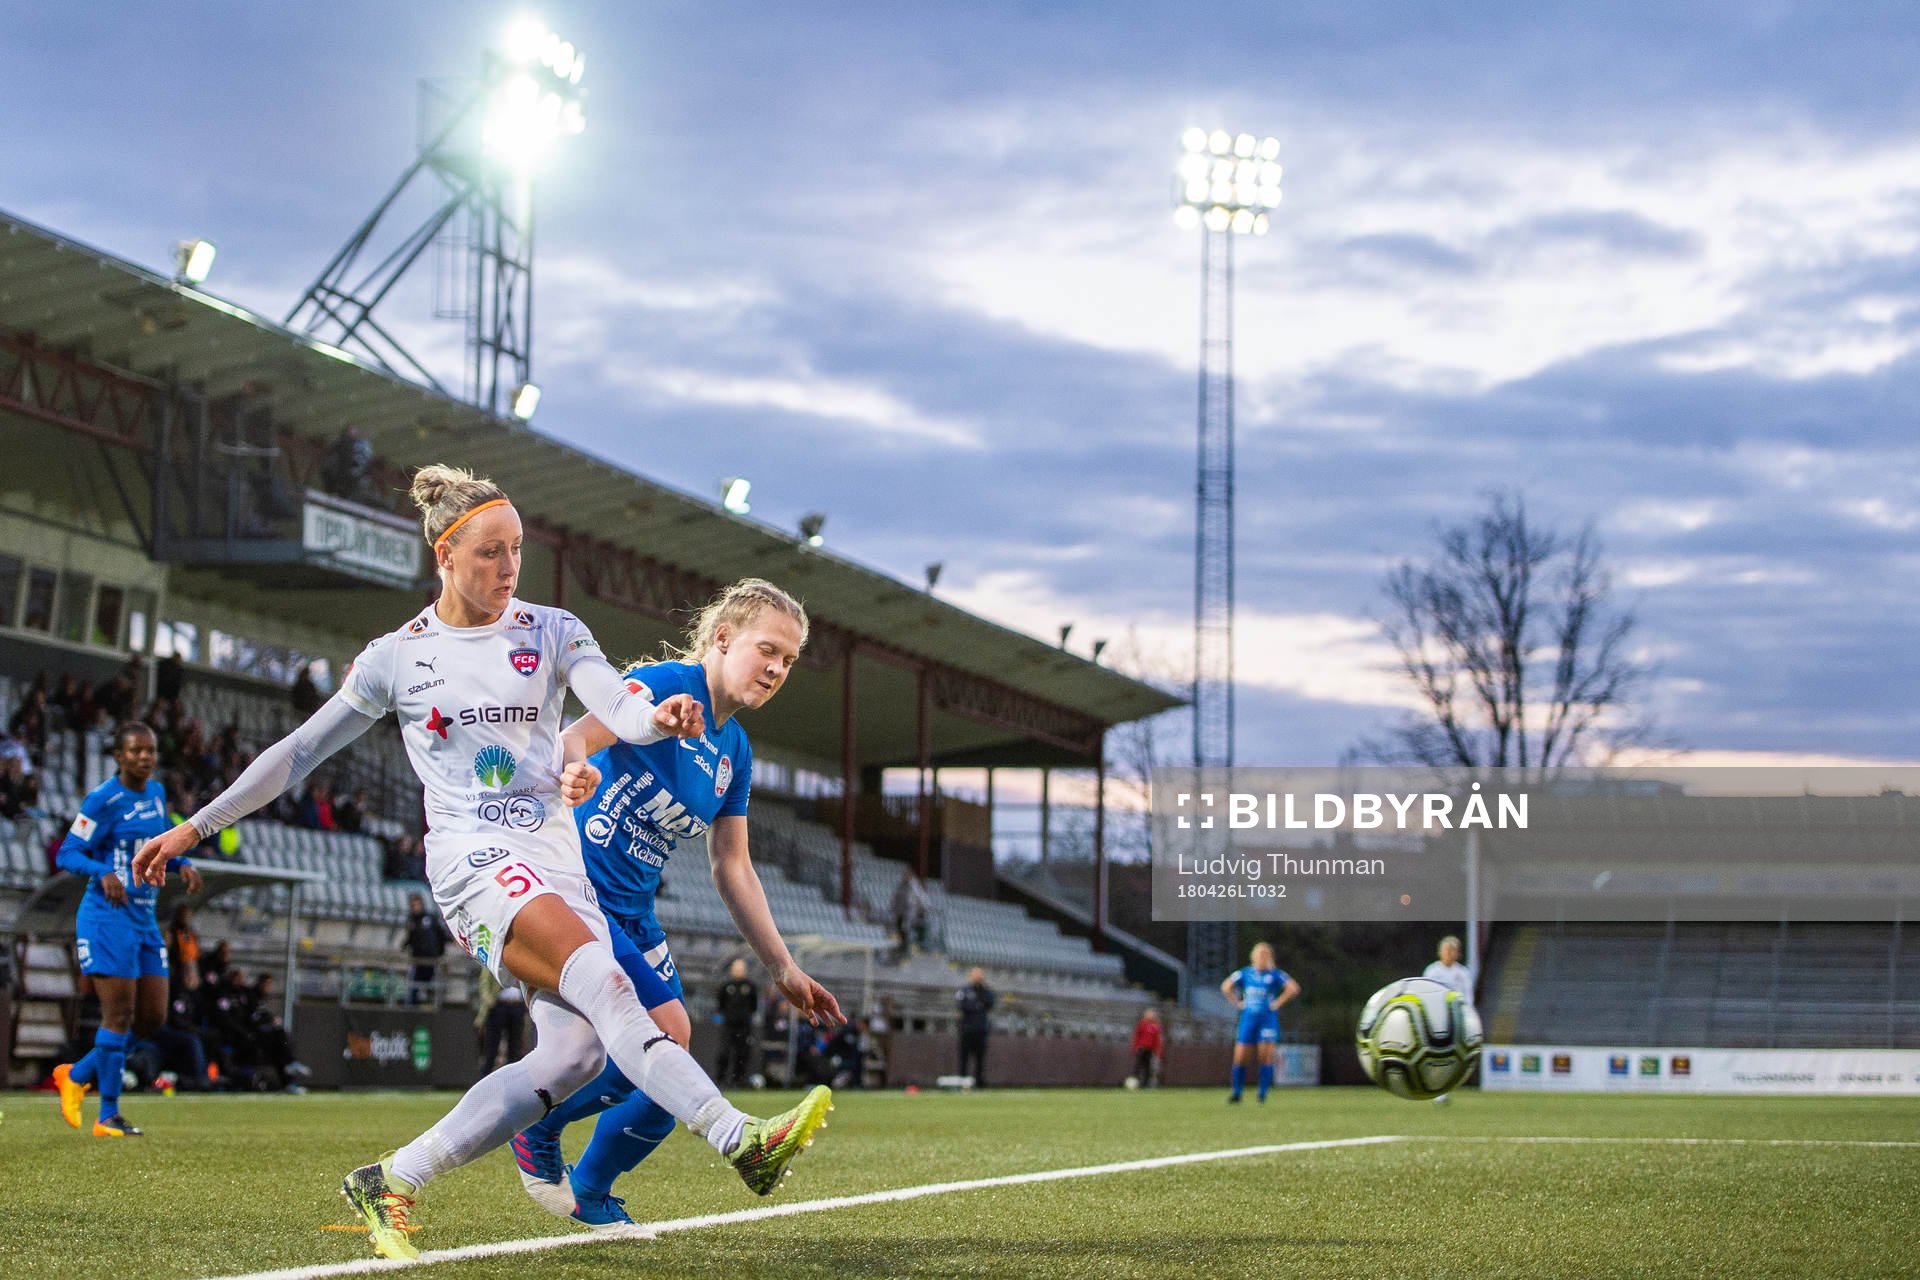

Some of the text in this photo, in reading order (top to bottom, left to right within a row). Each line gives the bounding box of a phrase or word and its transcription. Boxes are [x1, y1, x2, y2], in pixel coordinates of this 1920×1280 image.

[514, 655, 537, 665] FCR
[407, 678, 446, 696] stadium
[598, 772, 632, 812] Eskilstuna
[609, 770, 655, 820] Energi & Miljö
[494, 862, 545, 898] 51
